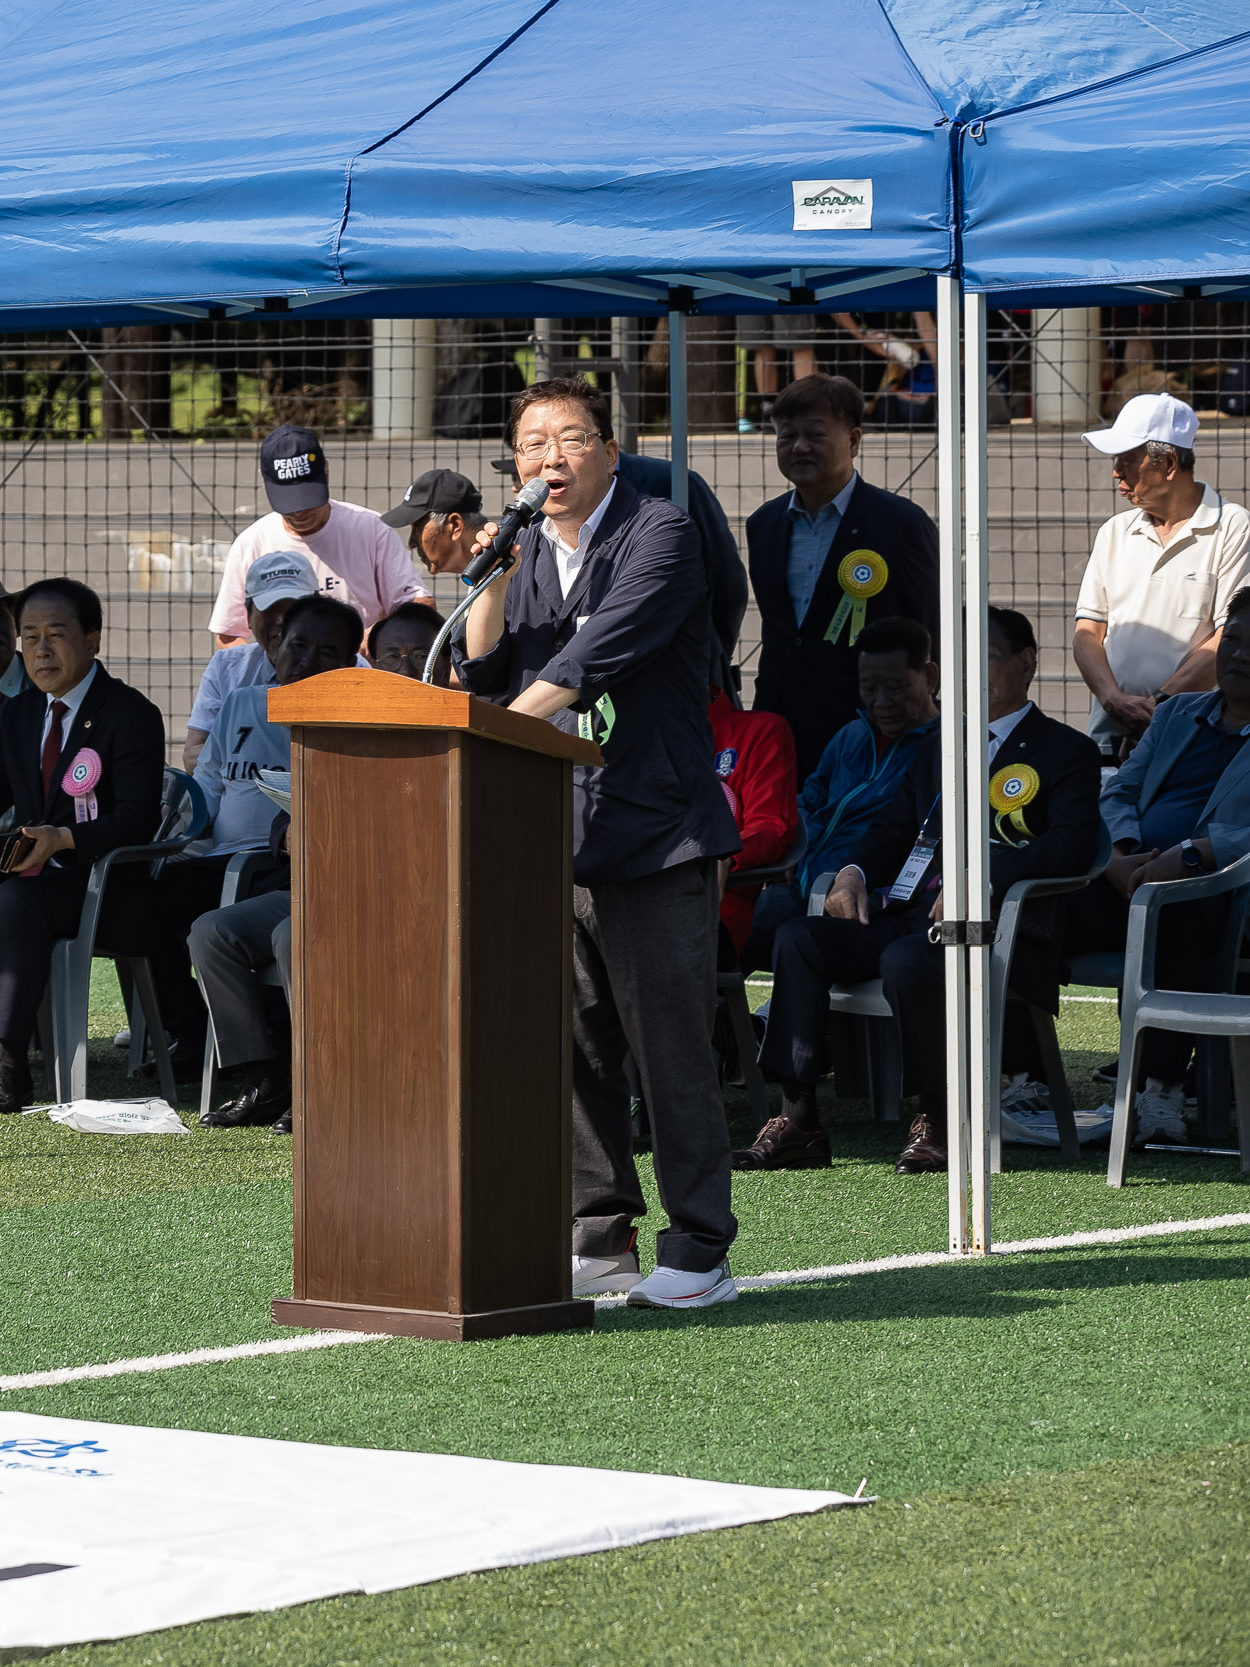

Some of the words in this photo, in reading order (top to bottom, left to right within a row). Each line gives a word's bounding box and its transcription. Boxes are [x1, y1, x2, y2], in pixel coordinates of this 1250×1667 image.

[803, 196, 864, 206] CARAVAN
[273, 453, 309, 470] PEARLY
[277, 464, 312, 480] GATES
[260, 567, 302, 581] STUSSY
[231, 726, 255, 755] 7
